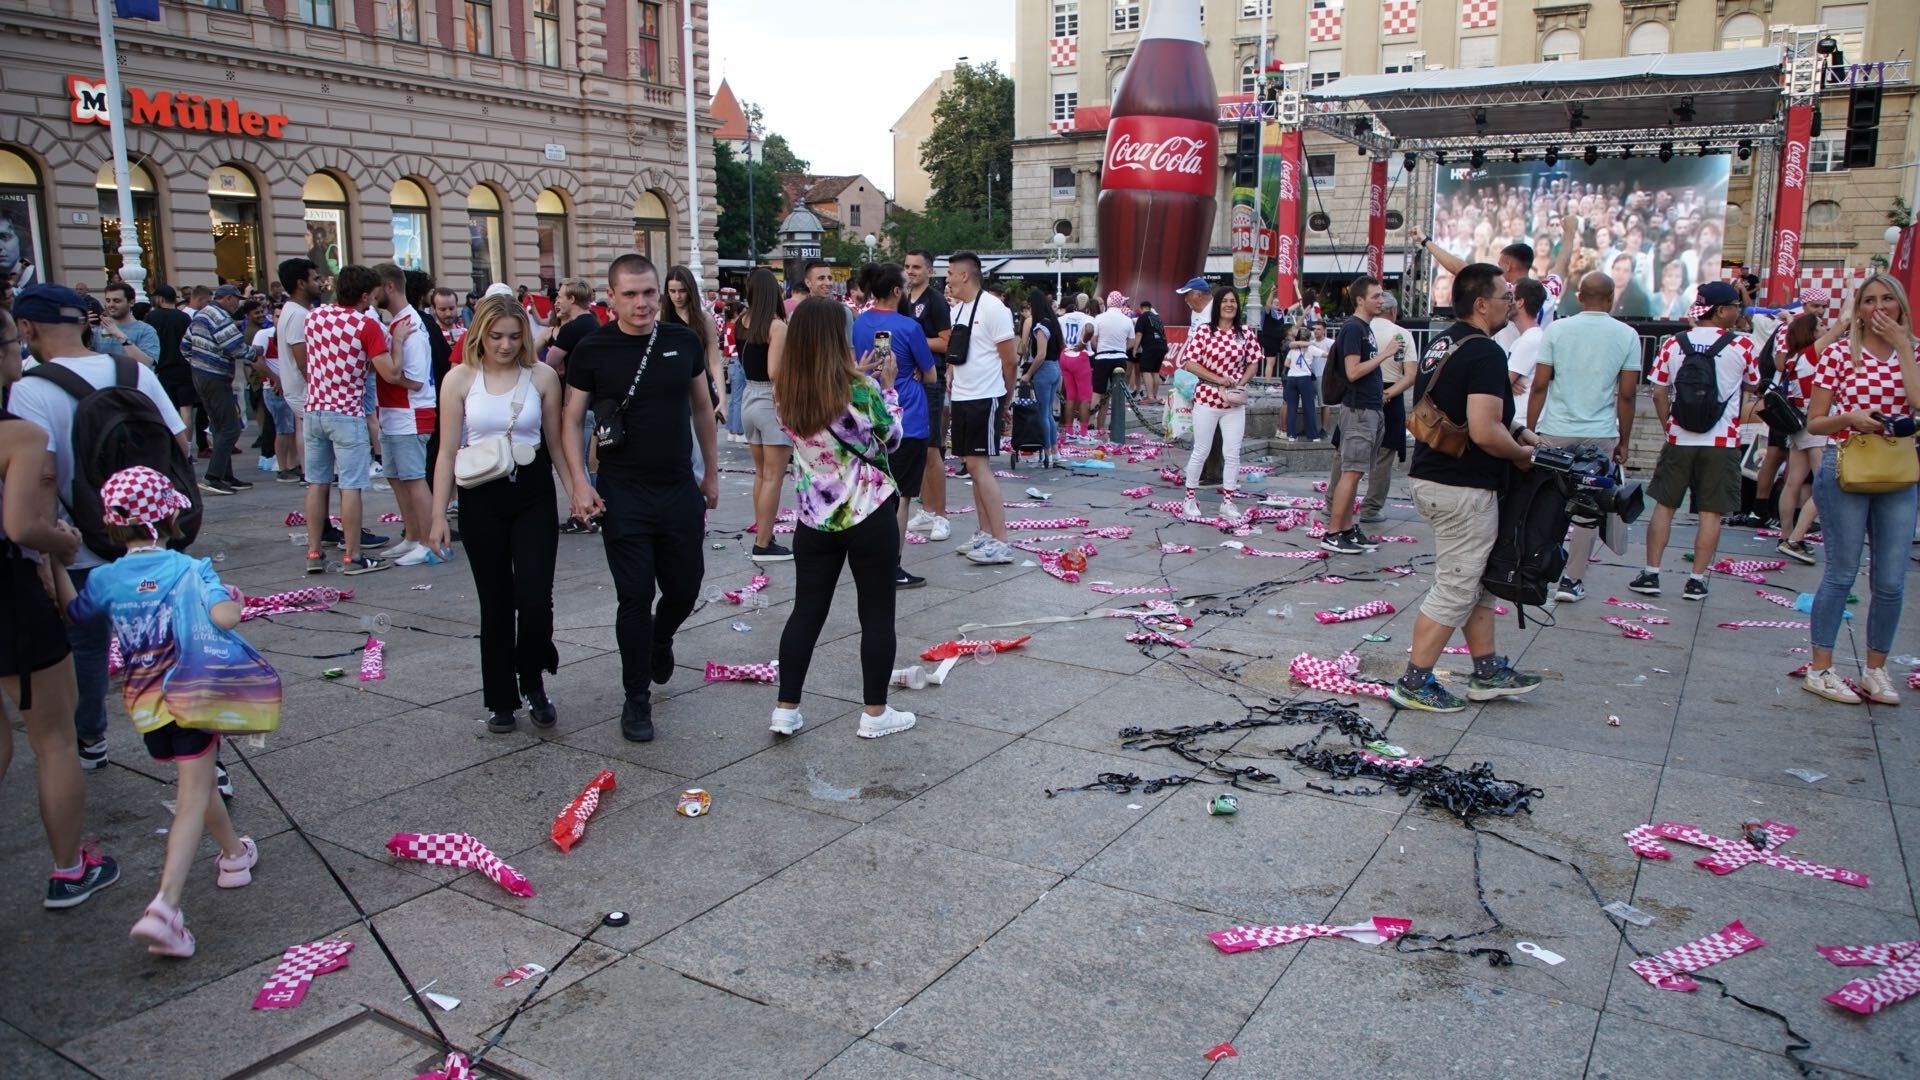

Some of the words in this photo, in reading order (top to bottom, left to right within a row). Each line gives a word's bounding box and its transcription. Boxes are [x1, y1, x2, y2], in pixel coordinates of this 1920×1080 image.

[127, 87, 289, 138] Müller
[1109, 134, 1208, 175] Coca-Cola
[1785, 140, 1806, 190] Coca-Cola
[1280, 160, 1294, 202] Coca-Cola
[1278, 235, 1292, 276] Coca-Cola
[1779, 229, 1799, 279] Coca-Cola
[1066, 322, 1079, 345] 10
[140, 579, 155, 588] dm
[203, 645, 229, 657] Signal
